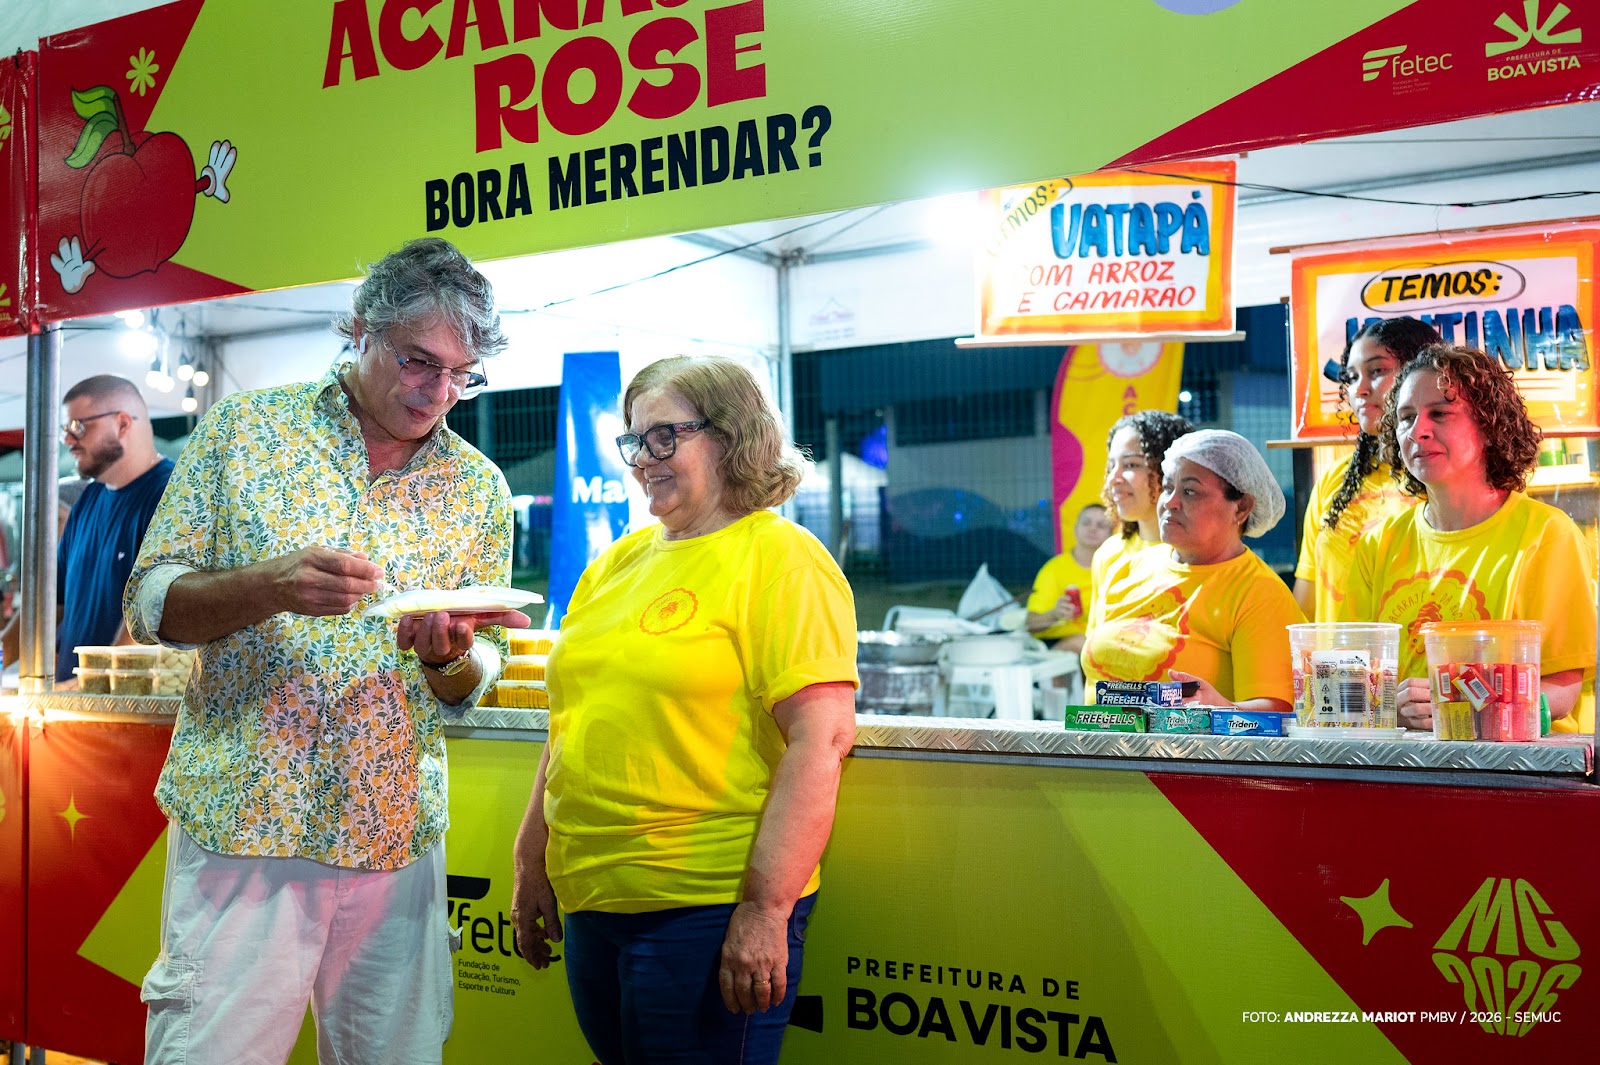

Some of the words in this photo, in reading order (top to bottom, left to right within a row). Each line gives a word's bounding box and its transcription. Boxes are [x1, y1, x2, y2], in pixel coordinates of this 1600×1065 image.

[1392, 52, 1453, 78] fetec
[1505, 50, 1550, 61] PREFEITURA
[474, 1, 767, 154] ROSE
[425, 162, 533, 232] BORA
[548, 105, 832, 212] MERENDAR?
[1022, 264, 1073, 286] OM
[1088, 260, 1175, 285] ARROZ
[1381, 268, 1503, 302] TEMOS:
[1017, 292, 1036, 313] E
[1101, 694, 1153, 706] FREEGELLS
[1075, 712, 1136, 725] FREEGELLS
[1227, 719, 1259, 728] Trident
[1432, 877, 1582, 961] MC
[458, 958, 490, 970] Fundação
[491, 963, 500, 971] de
[458, 969, 491, 982] Educação,
[492, 974, 521, 986] Turismo,
[458, 980, 484, 992] Esporte
[490, 985, 516, 996] Cultura
[848, 956, 1026, 994] PREFEITURA
[1042, 977, 1080, 1001] DE
[1431, 952, 1582, 1038] 2026
